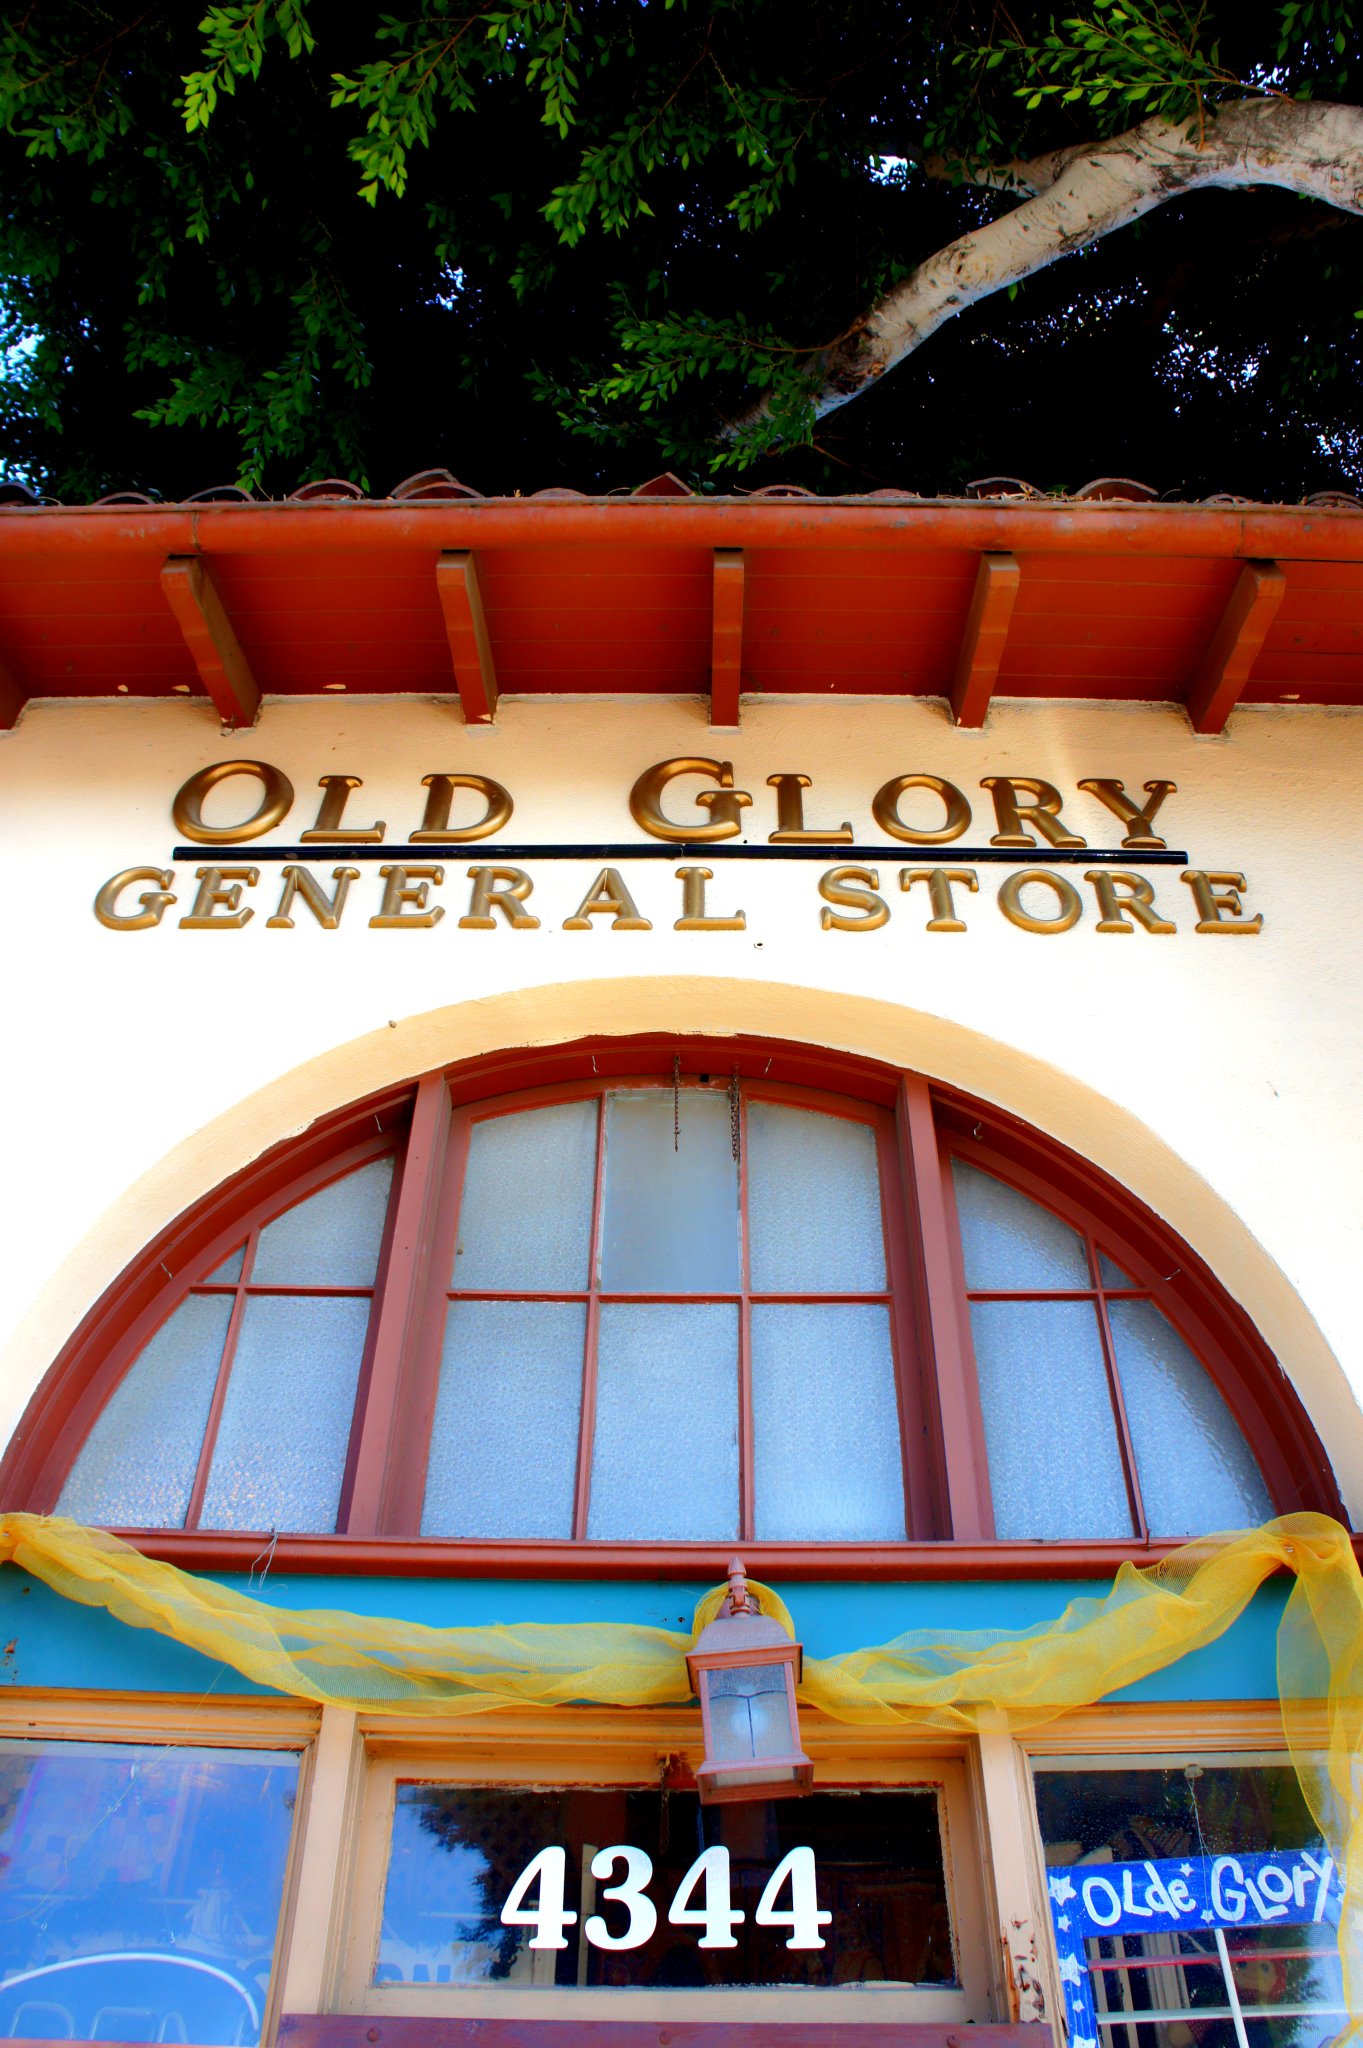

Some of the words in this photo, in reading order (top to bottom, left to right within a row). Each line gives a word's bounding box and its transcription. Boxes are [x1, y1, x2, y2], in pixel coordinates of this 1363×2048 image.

[172, 759, 514, 844] OLD
[629, 756, 1178, 849] GLORY
[94, 863, 747, 931] GENERAL
[818, 865, 1263, 934] STORE
[500, 1845, 833, 1951] 4344
